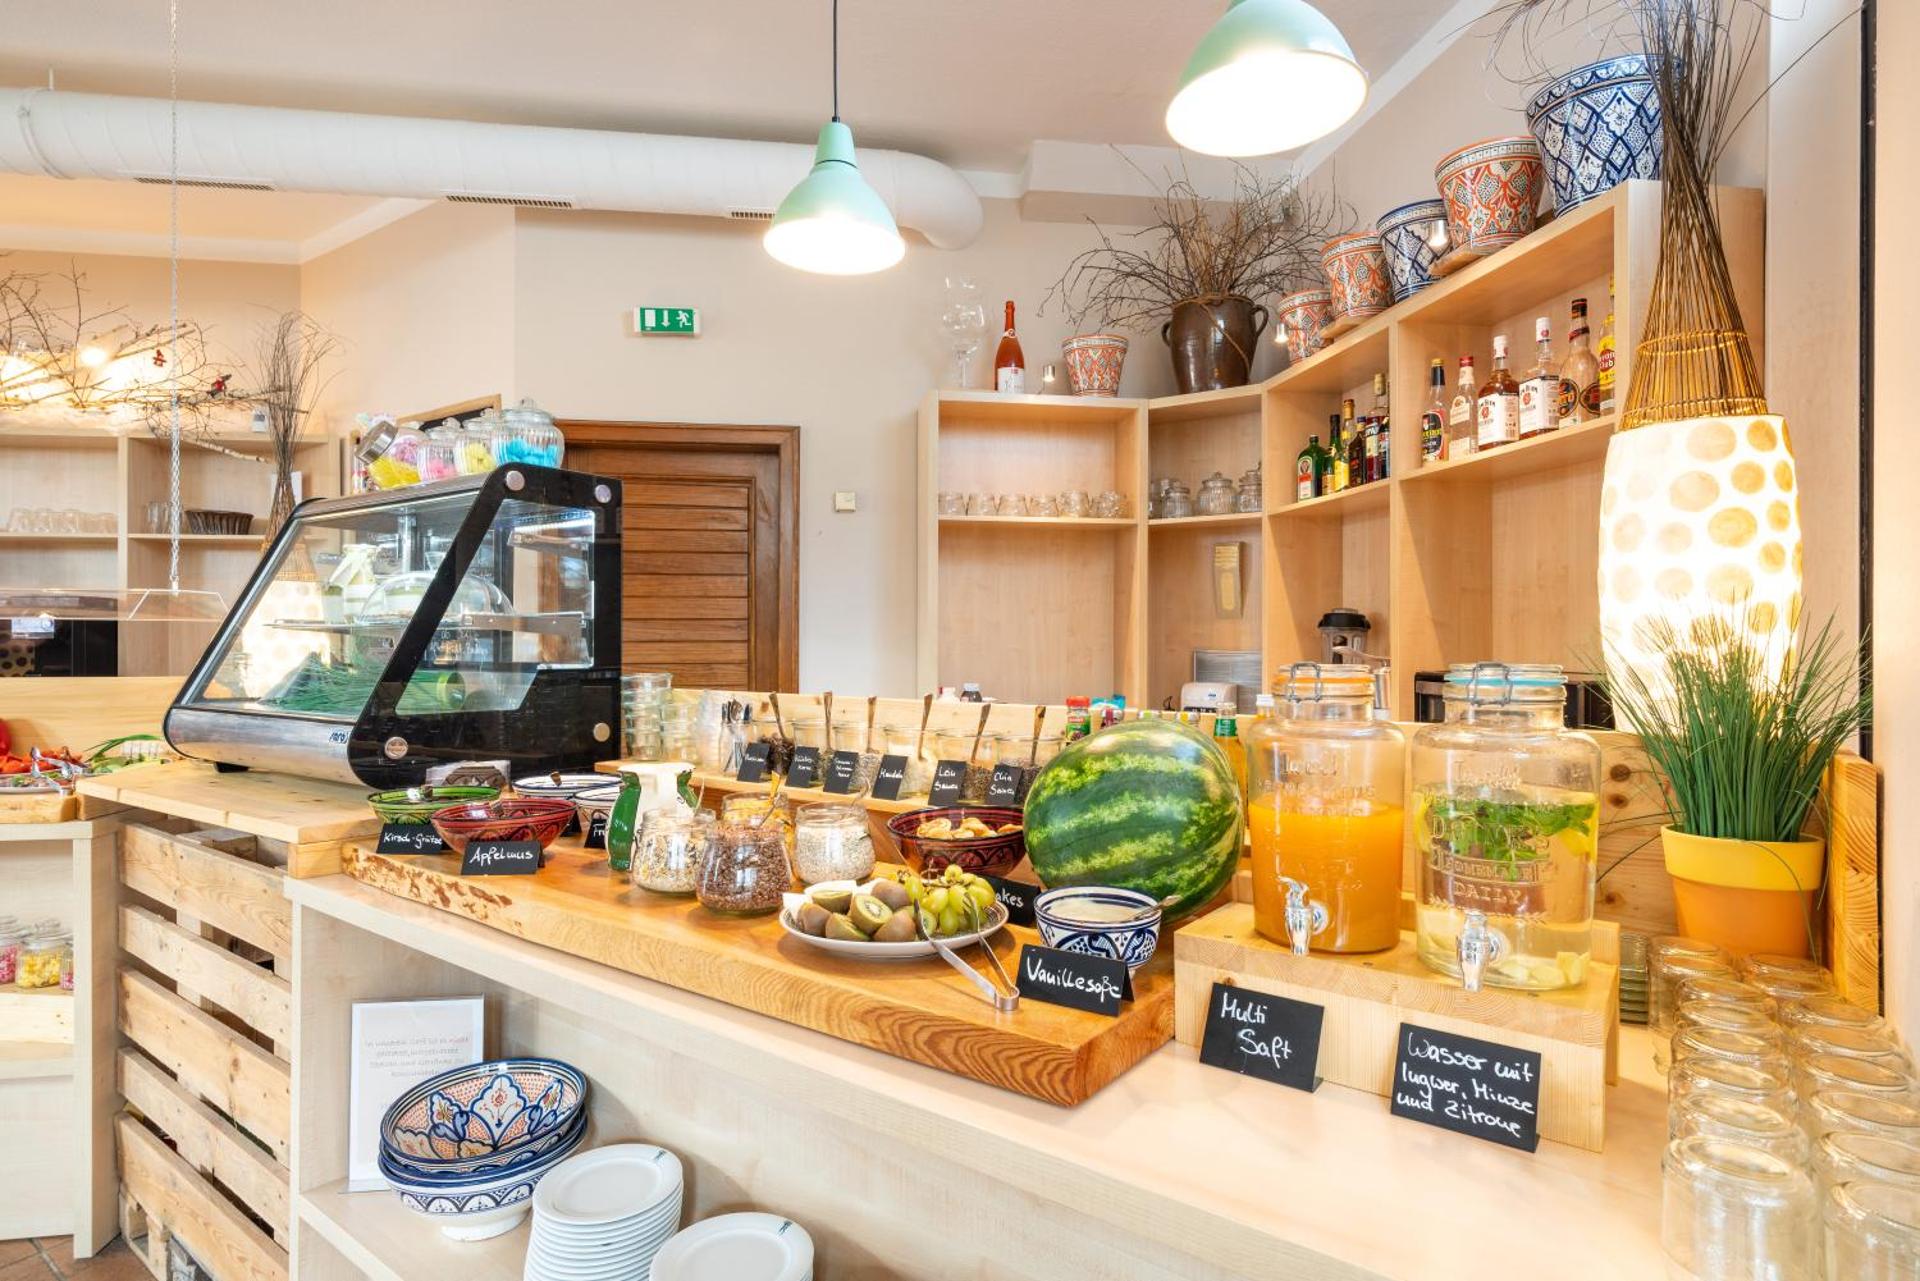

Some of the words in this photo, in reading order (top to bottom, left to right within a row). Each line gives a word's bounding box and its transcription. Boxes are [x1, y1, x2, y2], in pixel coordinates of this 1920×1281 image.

[469, 847, 534, 867] Apfelmus
[996, 888, 1024, 908] akes
[1220, 991, 1268, 1025] Multi
[1238, 1028, 1293, 1070] Saft
[1408, 1031, 1488, 1071] Wasser
[1494, 1061, 1534, 1083] mit
[1396, 1092, 1434, 1112] und
[1444, 1099, 1522, 1139] Zitrone
